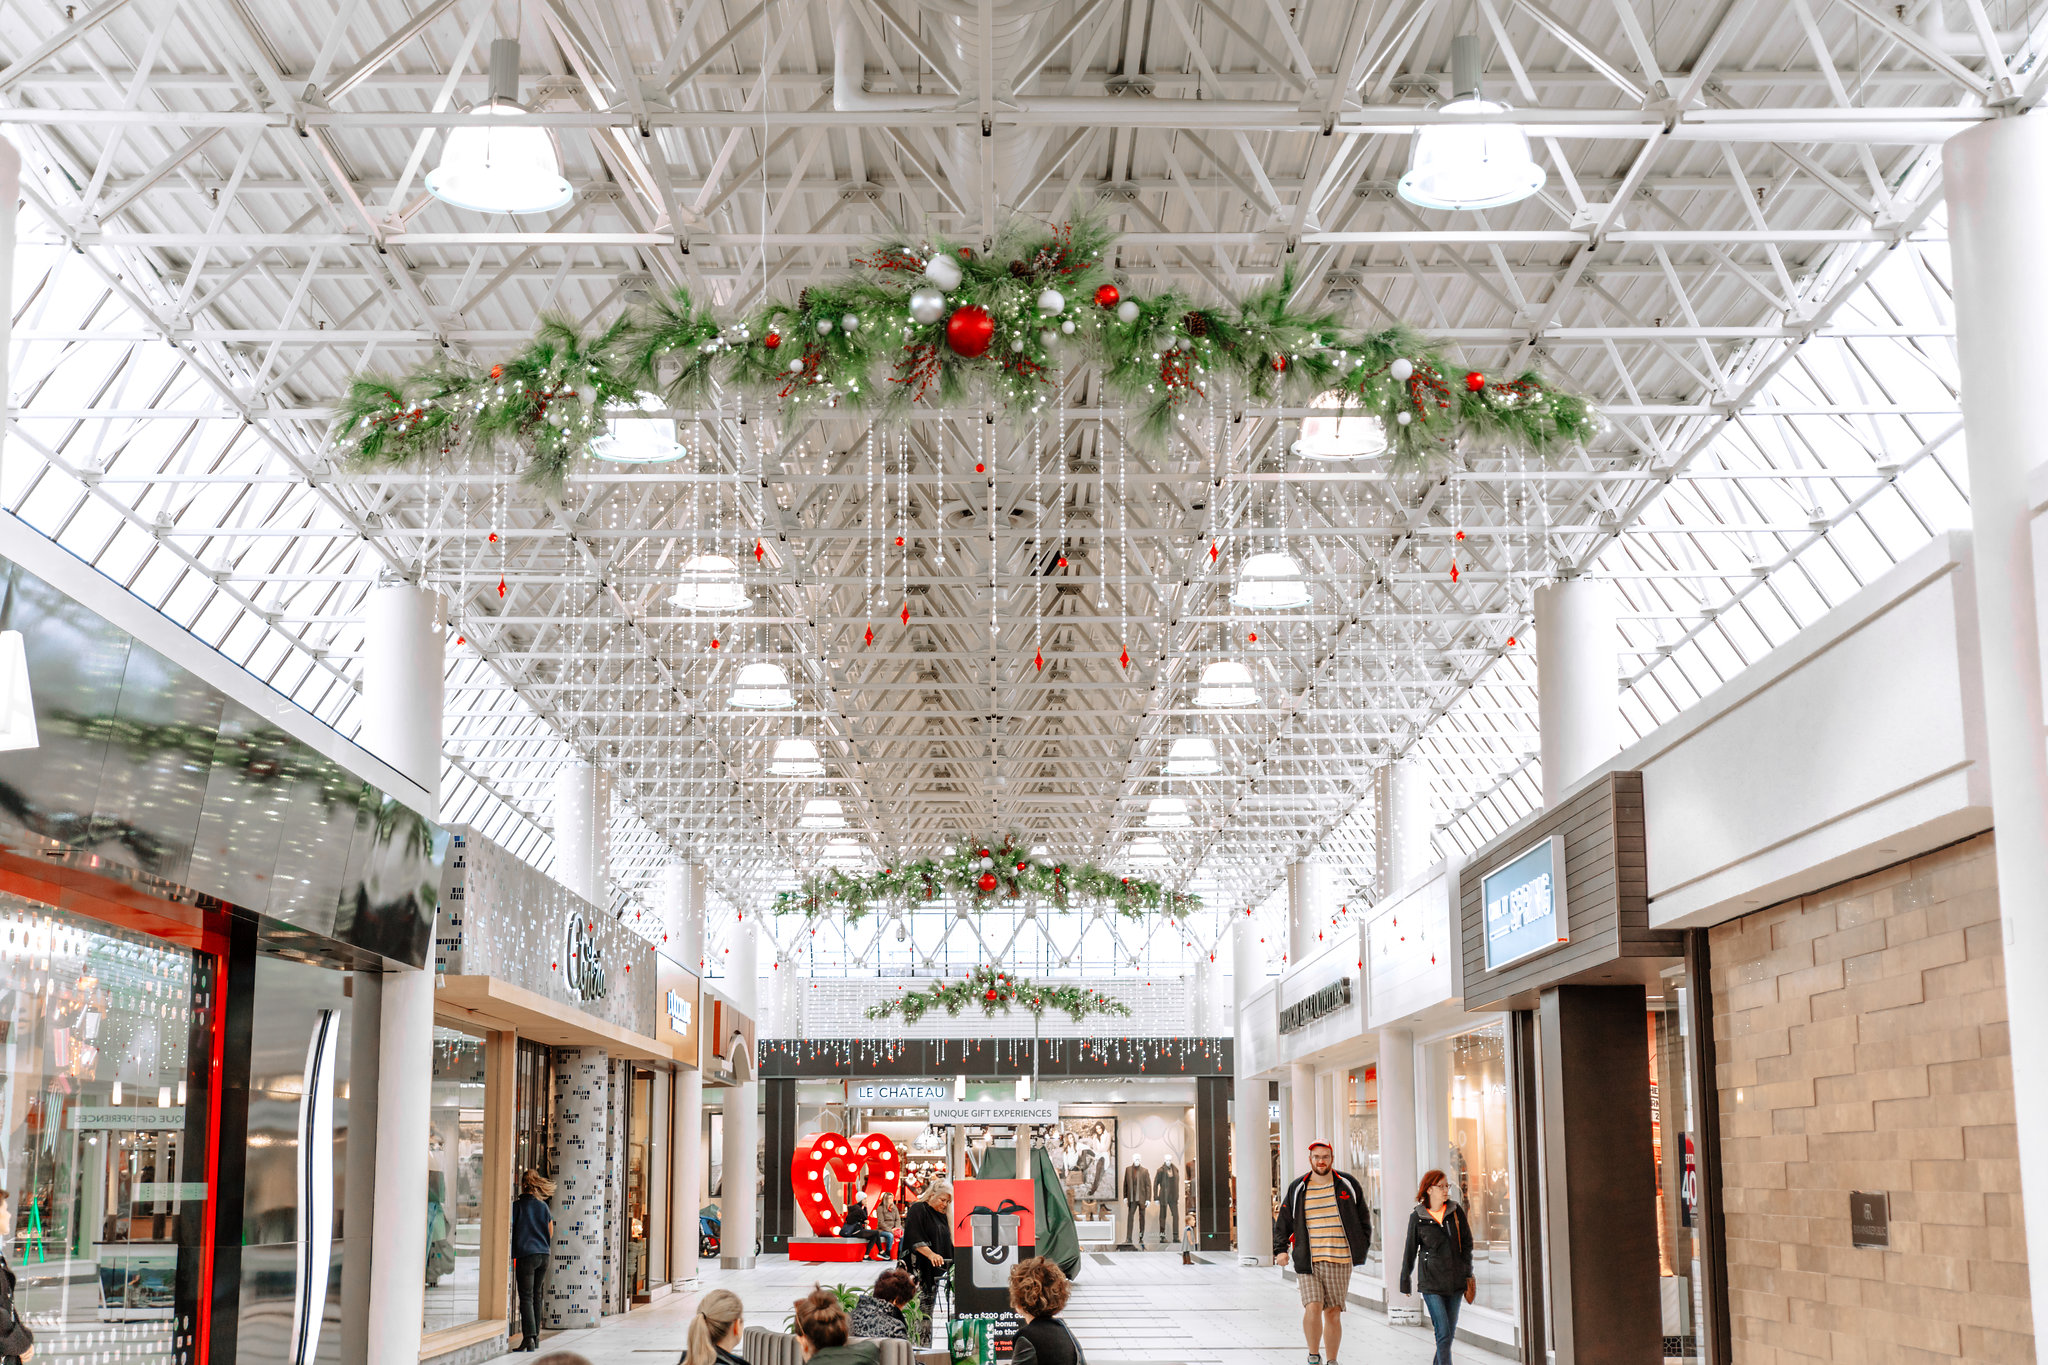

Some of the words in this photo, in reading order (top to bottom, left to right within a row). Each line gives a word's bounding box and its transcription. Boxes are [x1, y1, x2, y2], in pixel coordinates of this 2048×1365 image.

[859, 1087, 873, 1098] LE
[879, 1083, 944, 1098] CHÂTEAU
[933, 1109, 969, 1118] UNIQUE
[971, 1109, 991, 1118] GIFT
[993, 1109, 1052, 1118] EXPERIENCES
[1682, 1170, 1698, 1206] 40
[1000, 1311, 1013, 1320] gift
